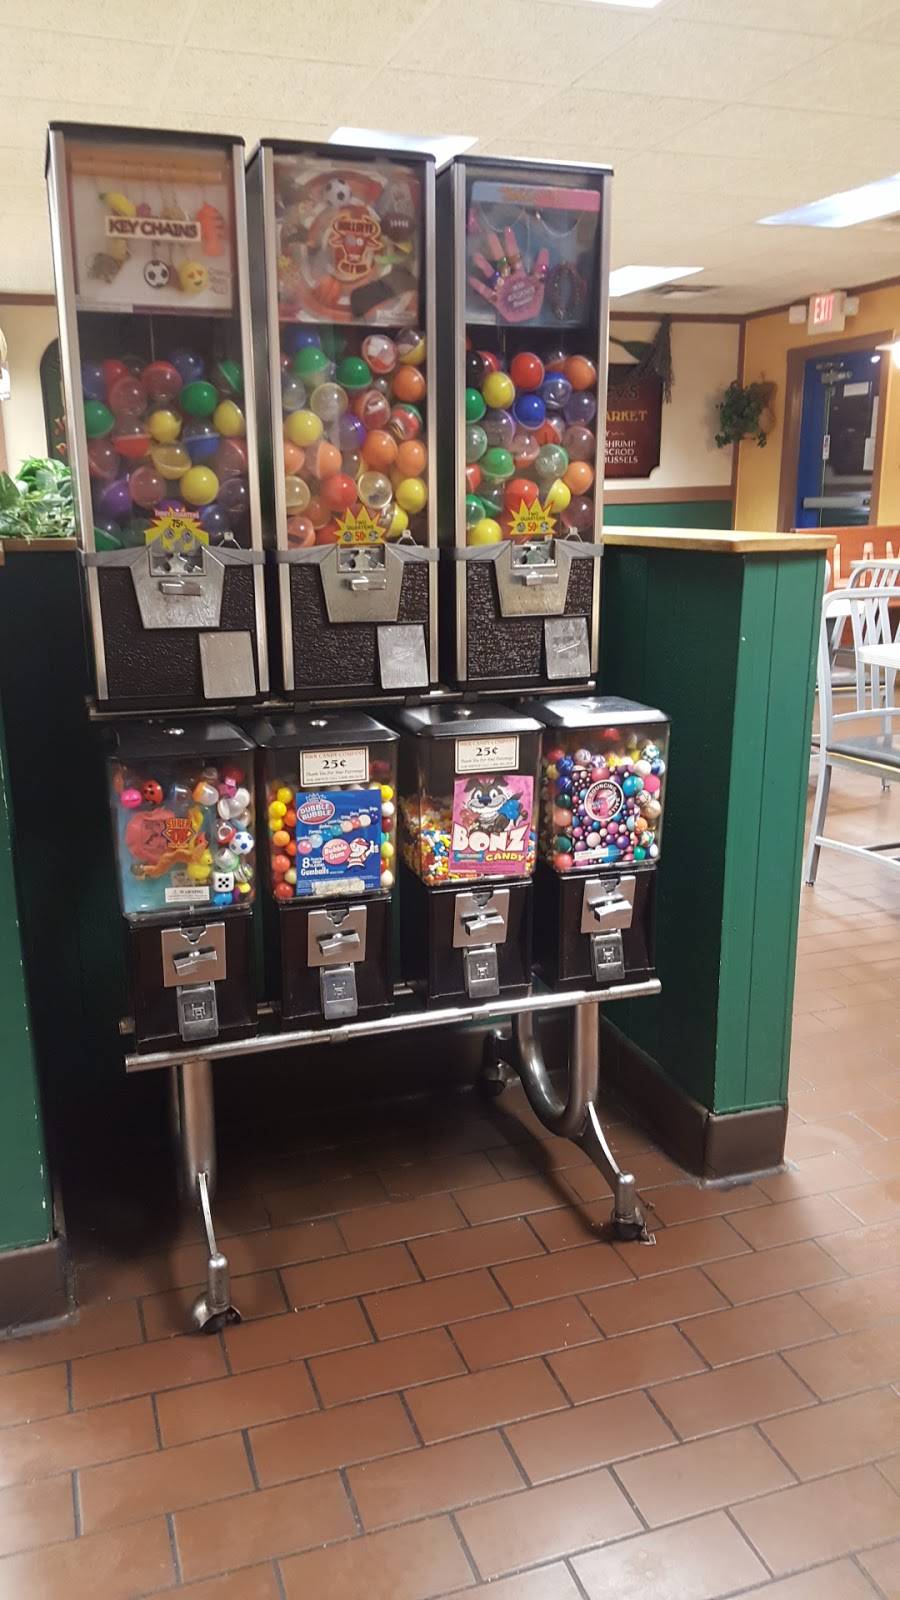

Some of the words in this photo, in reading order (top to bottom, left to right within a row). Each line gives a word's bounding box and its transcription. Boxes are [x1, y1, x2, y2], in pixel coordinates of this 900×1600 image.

[108, 218, 138, 234] KEY
[140, 219, 198, 237] CHAINS
[814, 293, 835, 324] EXIT
[606, 409, 648, 421] ARKET
[476, 746, 498, 757] 25¢
[321, 759, 347, 770] 25¢
[300, 803, 330, 814] DUBBLE
[302, 809, 332, 821] BUBBLE
[452, 822, 530, 852] BONZ
[324, 843, 348, 854] Bubble
[329, 851, 345, 860] Gum
[485, 852, 525, 862] CANDY
[302, 857, 311, 869] 8
[301, 867, 329, 876] Gumballs
